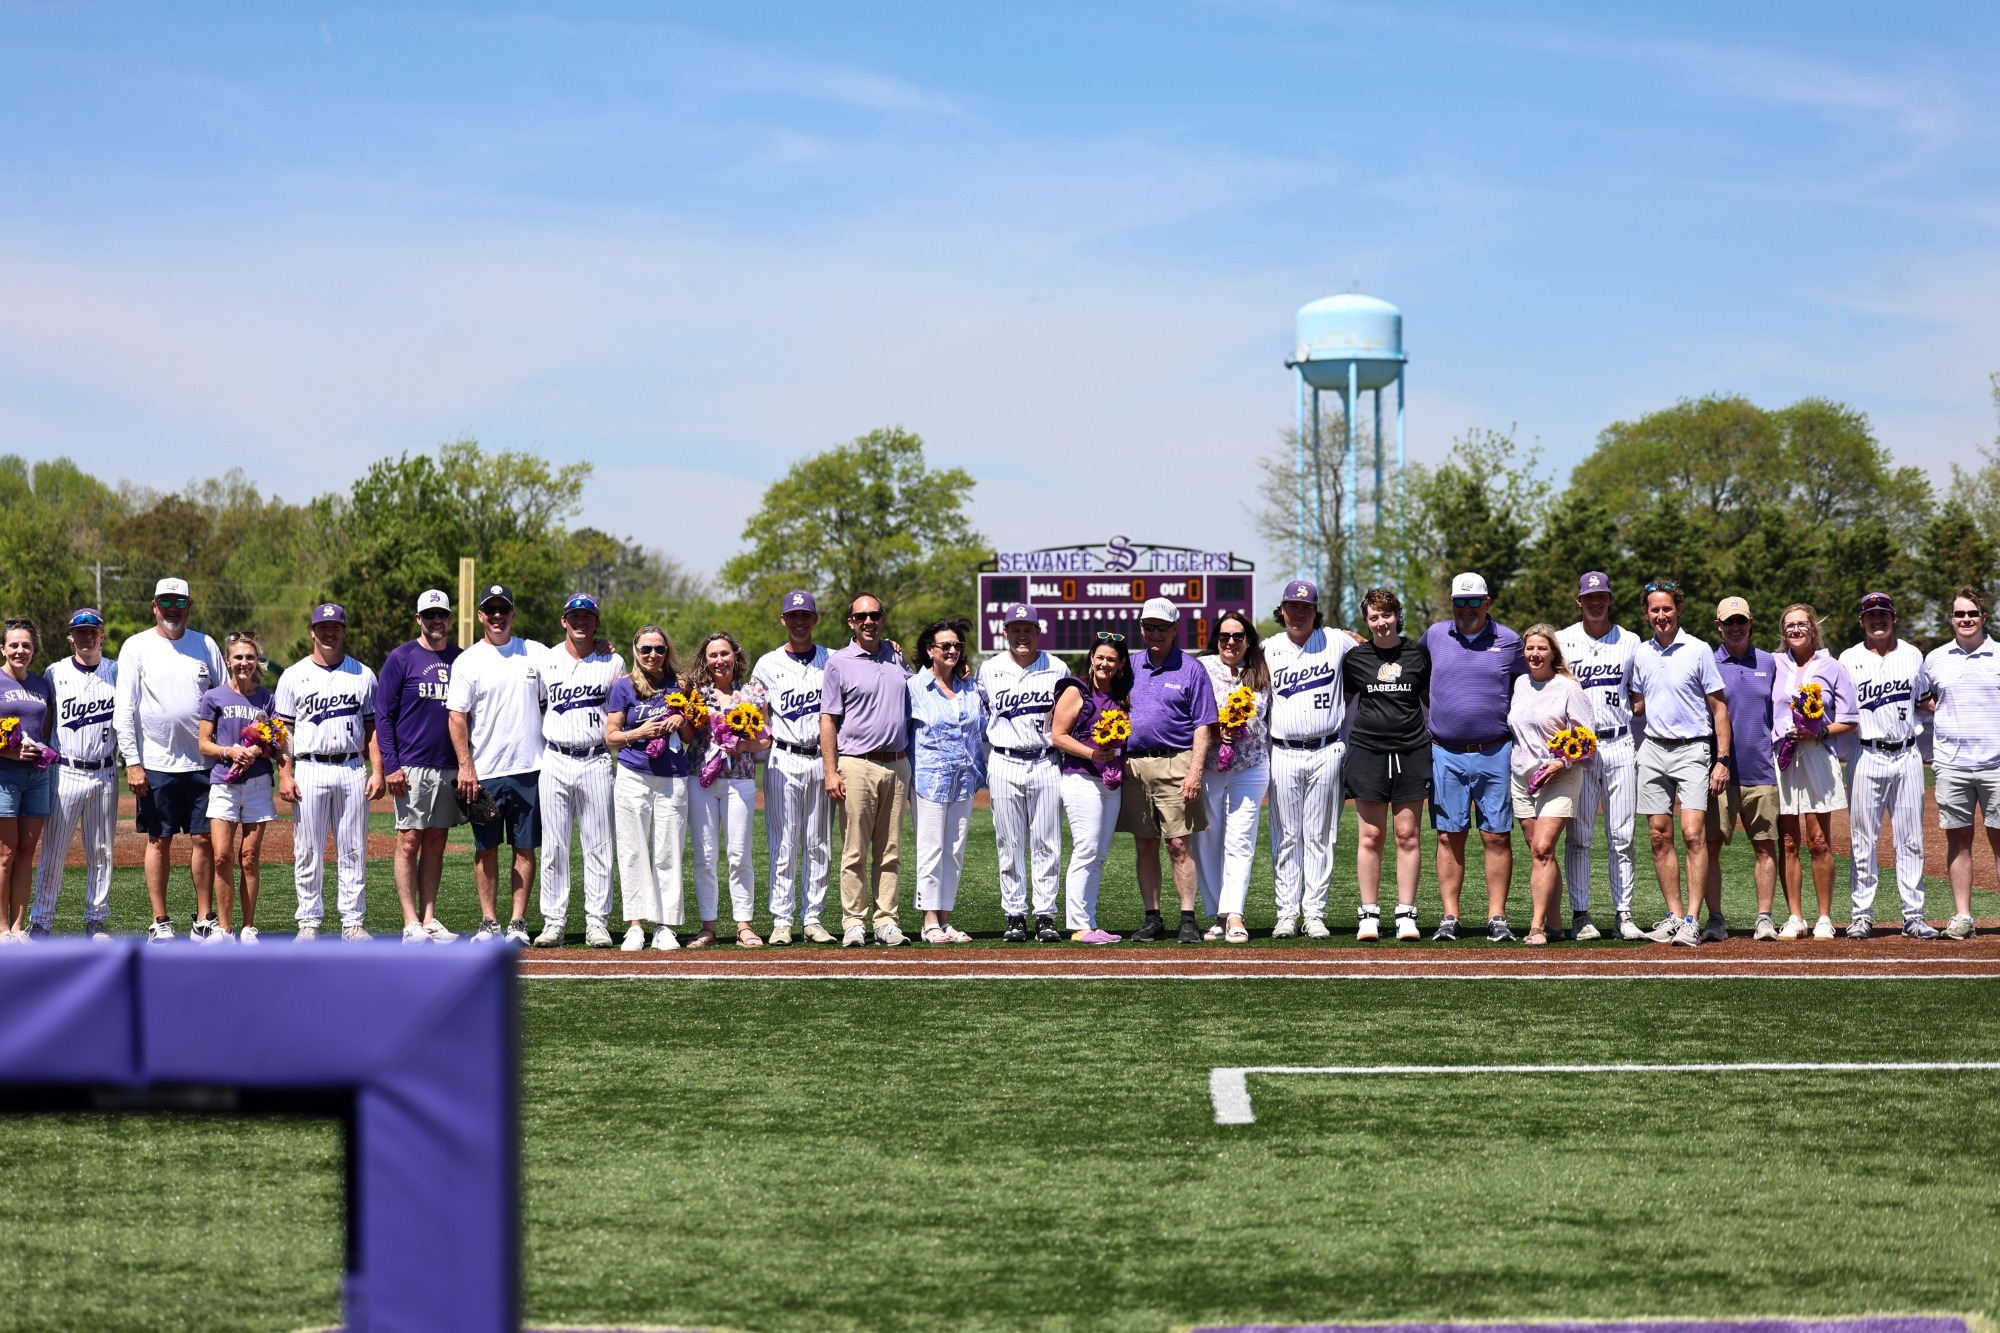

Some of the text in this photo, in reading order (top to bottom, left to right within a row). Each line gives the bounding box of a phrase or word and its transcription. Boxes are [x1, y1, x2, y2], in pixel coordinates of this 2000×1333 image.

[999, 552, 1093, 571] SEWANEE
[1104, 535, 1137, 571] S
[1150, 552, 1229, 571] TIGERS
[1030, 579, 1201, 601] BALL 0 STRIKE 0 OUT 0
[1069, 610, 1077, 620] 2
[1082, 610, 1090, 620] 3
[1094, 610, 1102, 620] 4
[437, 669, 449, 682] S
[1273, 662, 1334, 691] Tigers
[1570, 659, 1623, 685] Tigers
[550, 682, 605, 708] Tigers
[1366, 683, 1412, 693] BASEBALL
[1858, 678, 1911, 704] Tigers
[61, 696, 115, 724] Tigers
[304, 692, 360, 718] Tigers
[995, 688, 1054, 714] Tigers
[1314, 693, 1330, 709] 22
[346, 721, 354, 737] 4
[588, 712, 600, 728] 14
